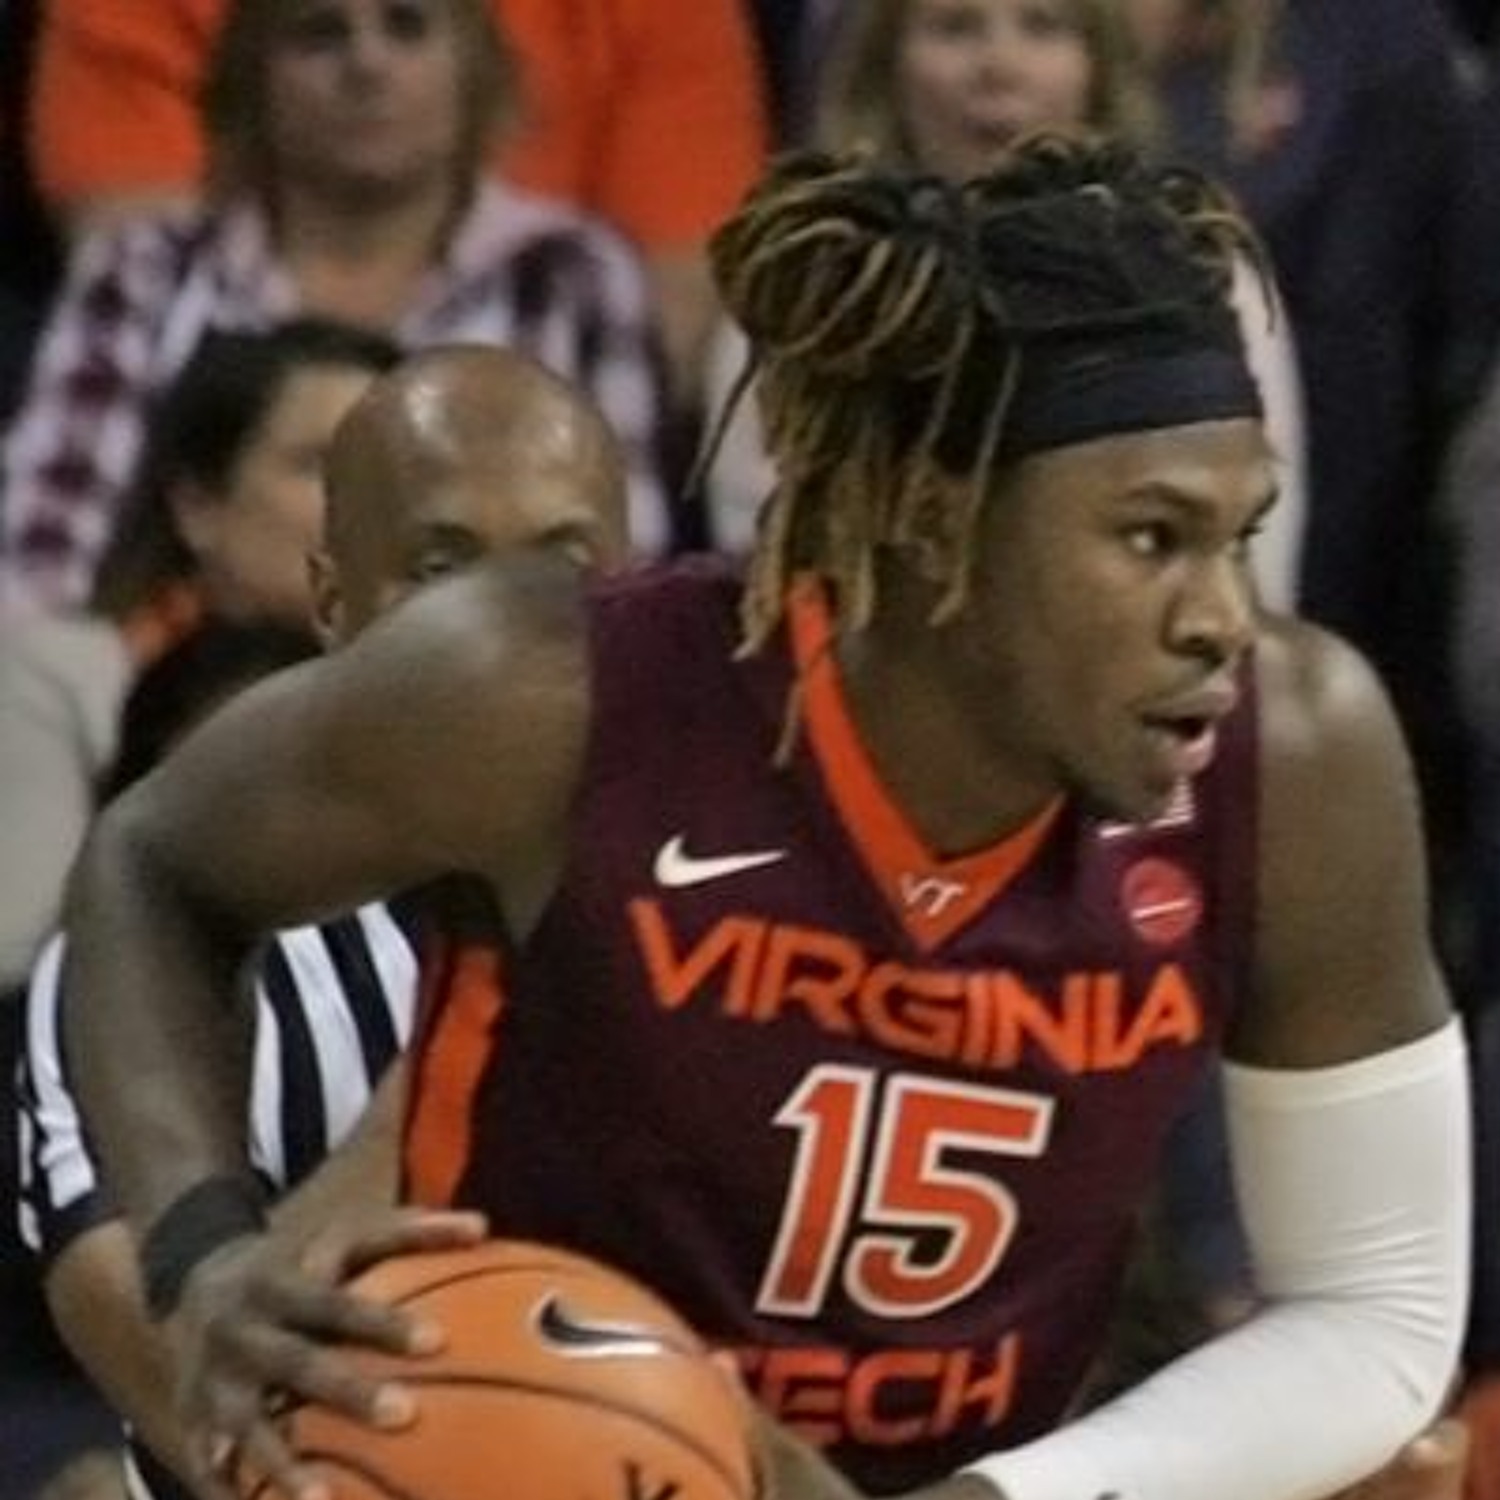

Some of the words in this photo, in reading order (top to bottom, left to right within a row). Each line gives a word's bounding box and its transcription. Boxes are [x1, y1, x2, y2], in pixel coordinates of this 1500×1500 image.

[628, 899, 1201, 1076] VIRGINIA
[755, 1062, 1054, 1318] 15
[740, 1333, 1022, 1446] ECH
